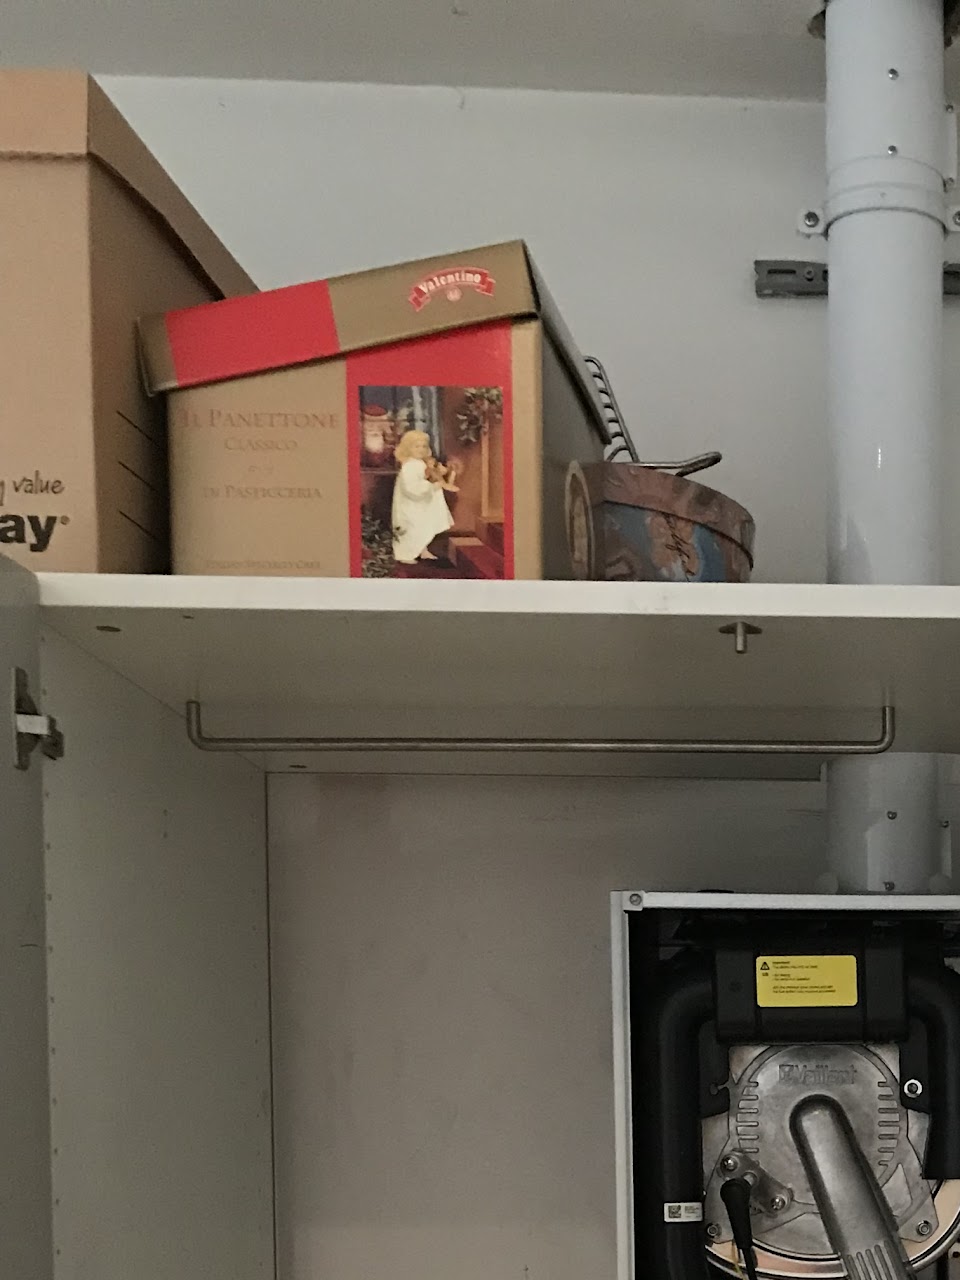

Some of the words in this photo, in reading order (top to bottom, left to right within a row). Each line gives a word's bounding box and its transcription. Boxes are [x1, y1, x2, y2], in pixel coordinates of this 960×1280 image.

[419, 270, 481, 294] Valentino
[209, 408, 339, 429] PANETTONE
[12, 469, 65, 494] value
